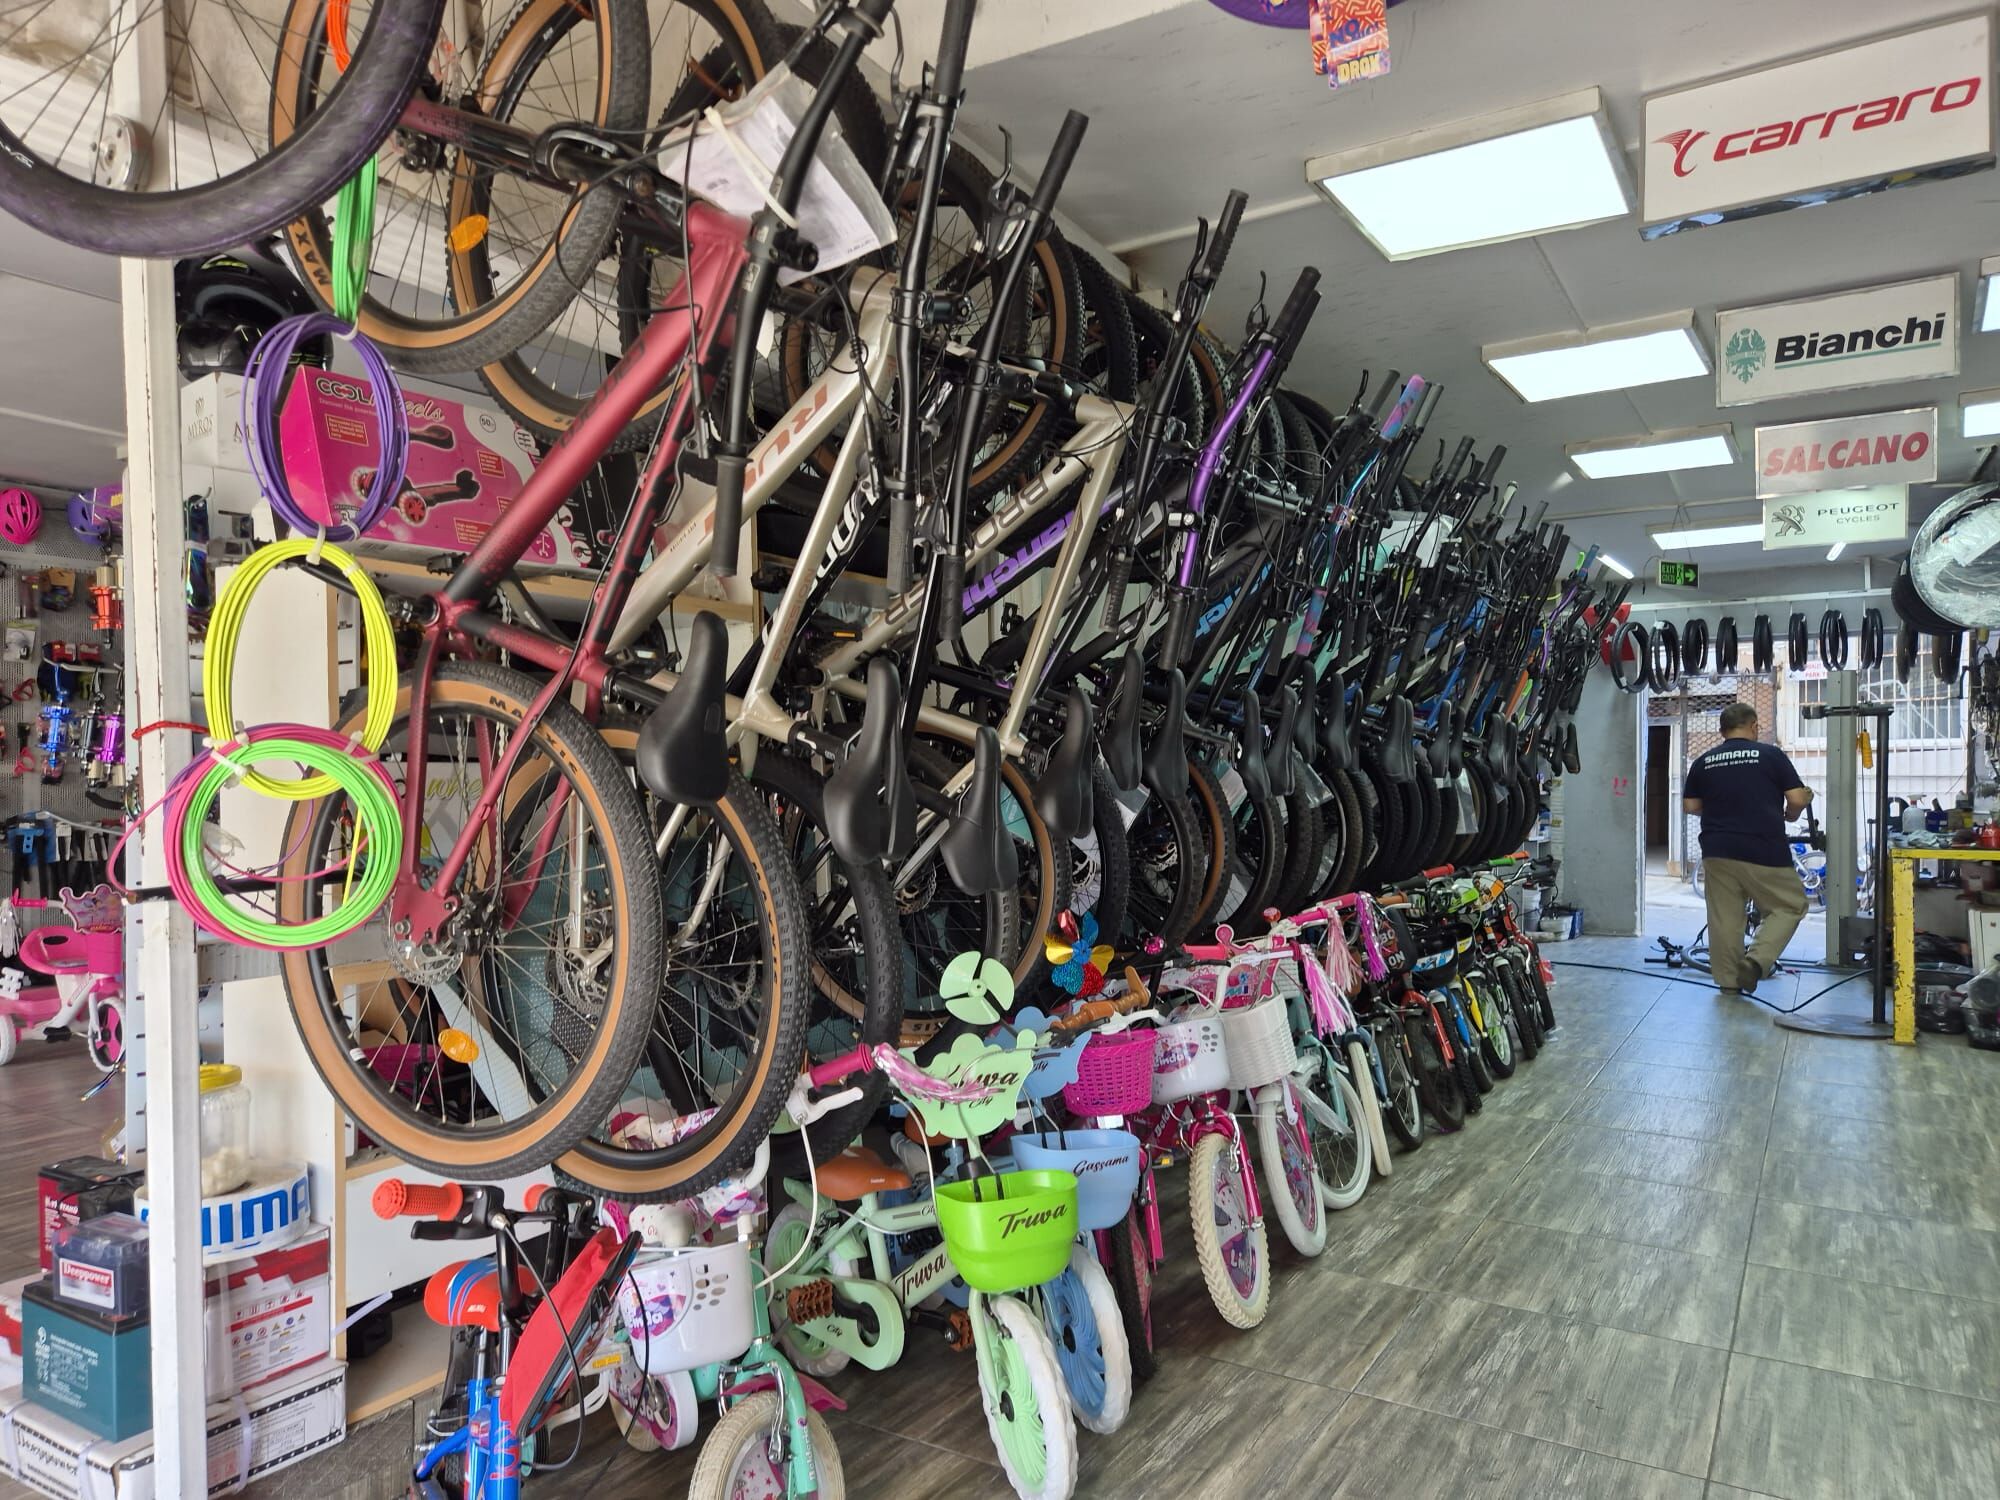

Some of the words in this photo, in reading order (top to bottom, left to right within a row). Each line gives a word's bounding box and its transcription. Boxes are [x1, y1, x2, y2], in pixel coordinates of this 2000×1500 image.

[1713, 77, 1981, 162] carraro
[1774, 312, 1946, 364] Bianchi
[1763, 431, 1930, 478] SALCANO
[1817, 502, 1900, 516] PEUGEOT
[1836, 514, 1881, 525] CYCLES
[963, 503, 1108, 616] ianchi
[1704, 750, 1760, 764] SHIMANO
[998, 1202, 1068, 1240] Truva
[895, 1253, 947, 1305] Truva
